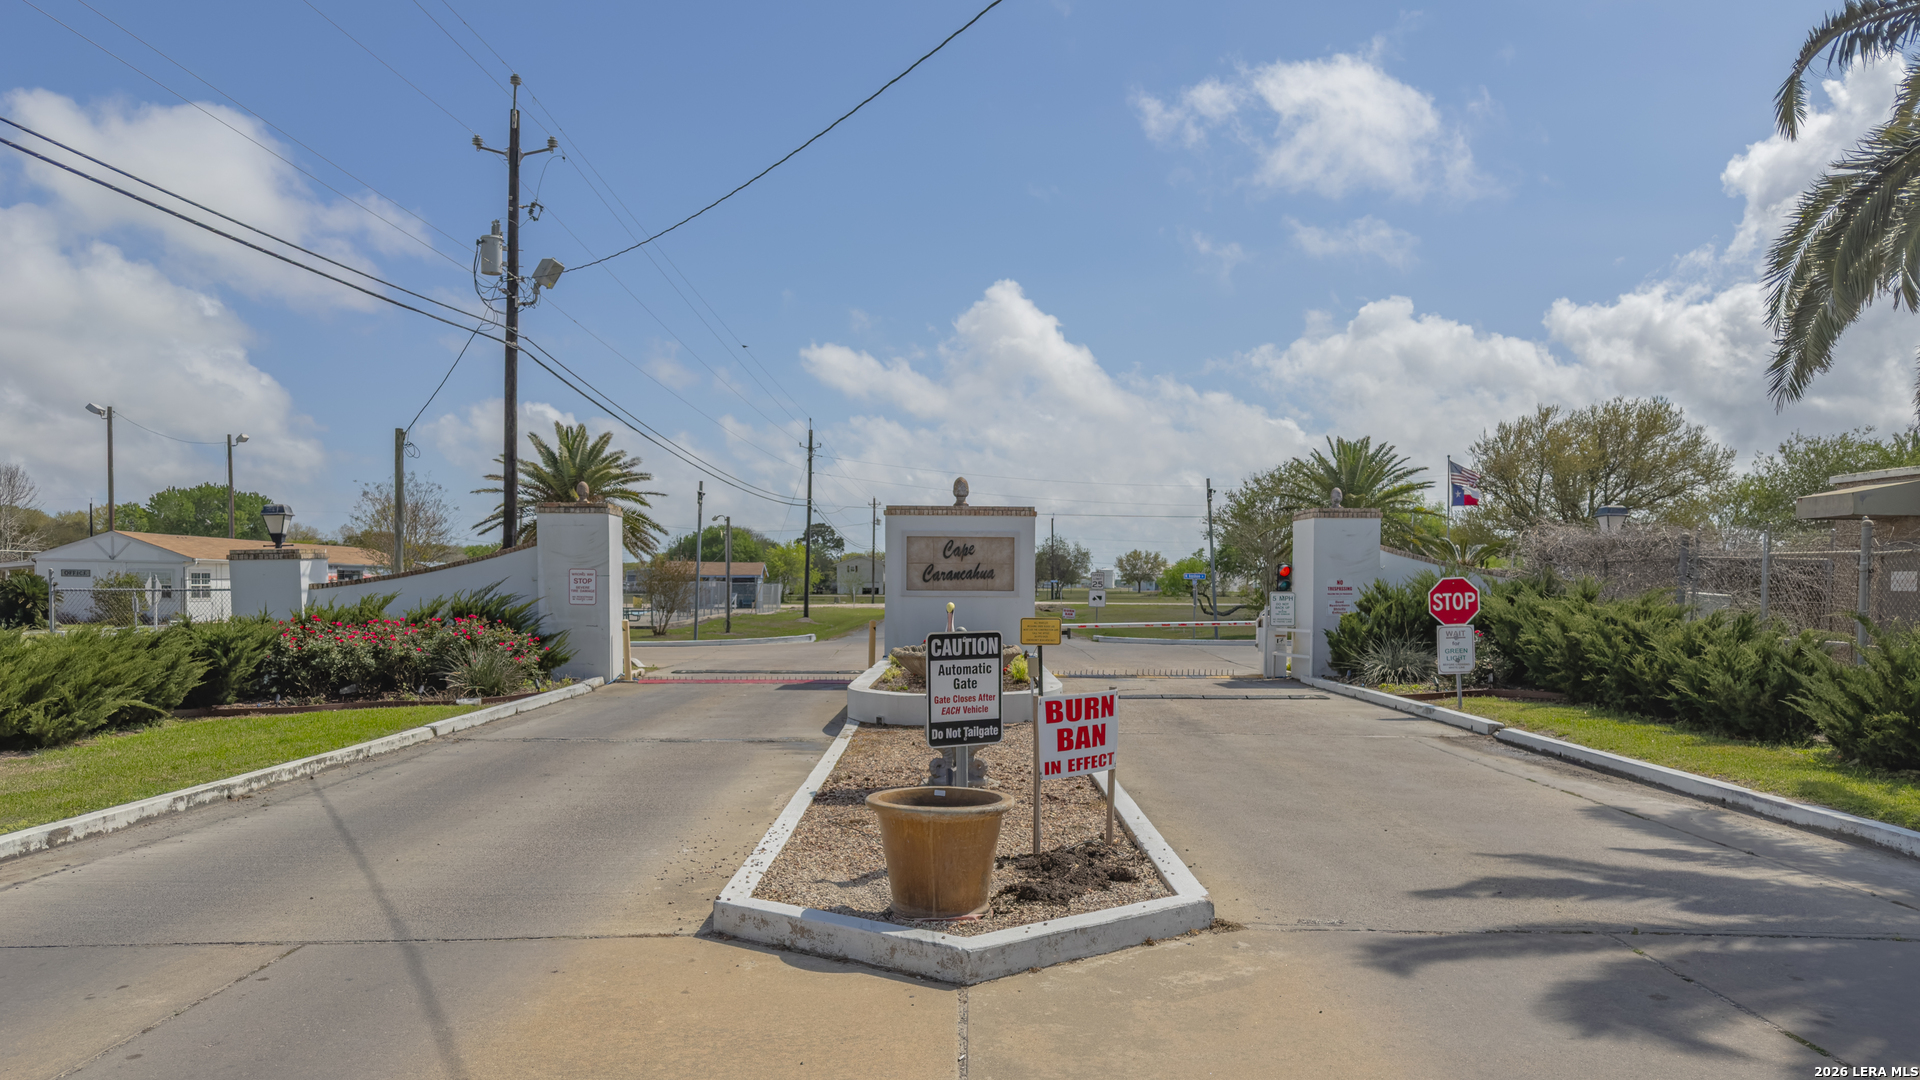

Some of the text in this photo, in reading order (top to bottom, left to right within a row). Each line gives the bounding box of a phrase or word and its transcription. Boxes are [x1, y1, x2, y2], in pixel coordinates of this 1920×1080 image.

[943, 540, 975, 561] Cape
[923, 563, 995, 583] Carancahua
[1432, 592, 1476, 611] STOP
[931, 637, 998, 657] CAUTION
[938, 663, 992, 676] Automatic
[953, 678, 977, 690] Gate
[934, 693, 996, 704] Gate Closes After
[941, 705, 988, 715] EACH Vehicle
[1045, 694, 1114, 724] BURN
[932, 725, 999, 740] Do Not Tailgate
[1057, 723, 1106, 752] BAN
[1044, 752, 1114, 775] IN EFFECT
